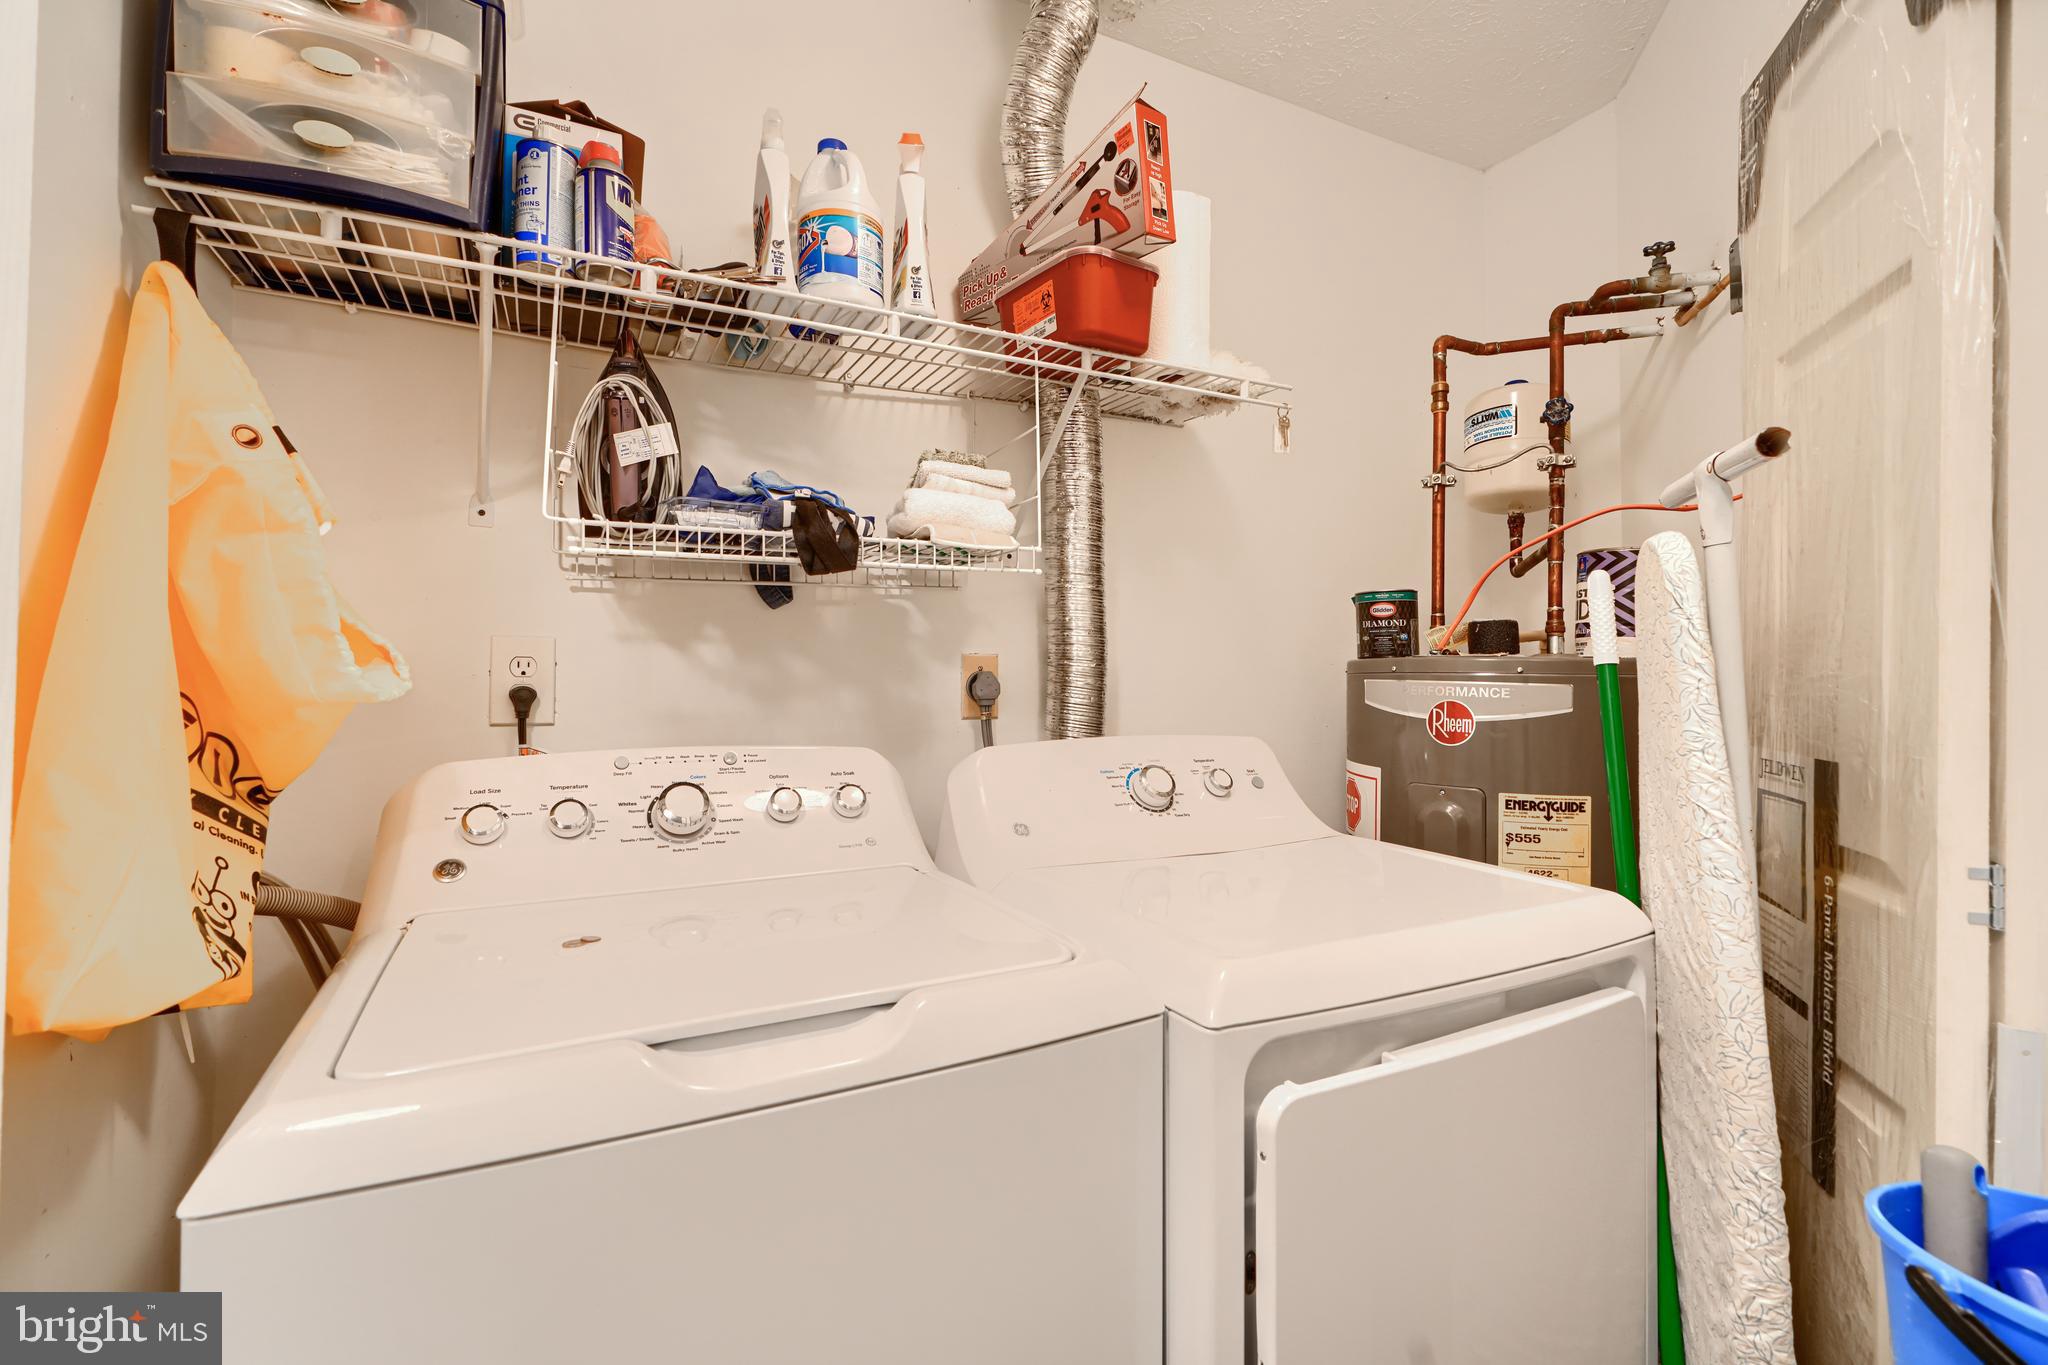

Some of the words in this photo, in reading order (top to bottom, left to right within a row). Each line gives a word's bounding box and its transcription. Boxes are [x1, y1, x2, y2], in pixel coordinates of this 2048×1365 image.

[963, 282, 984, 297] Pick
[1471, 411, 1499, 427] WATTS
[1362, 619, 1406, 628] DIAMOND
[1402, 686, 1511, 698] PERFORMANCE
[1433, 702, 1472, 738] Rheem
[1505, 799, 1586, 815] ENERGYGUIDE
[1505, 832, 1541, 844] $555
[1823, 874, 1834, 946] 6-Panel
[1823, 953, 1834, 1024] Molded
[1822, 1030, 1834, 1086] Bifold
